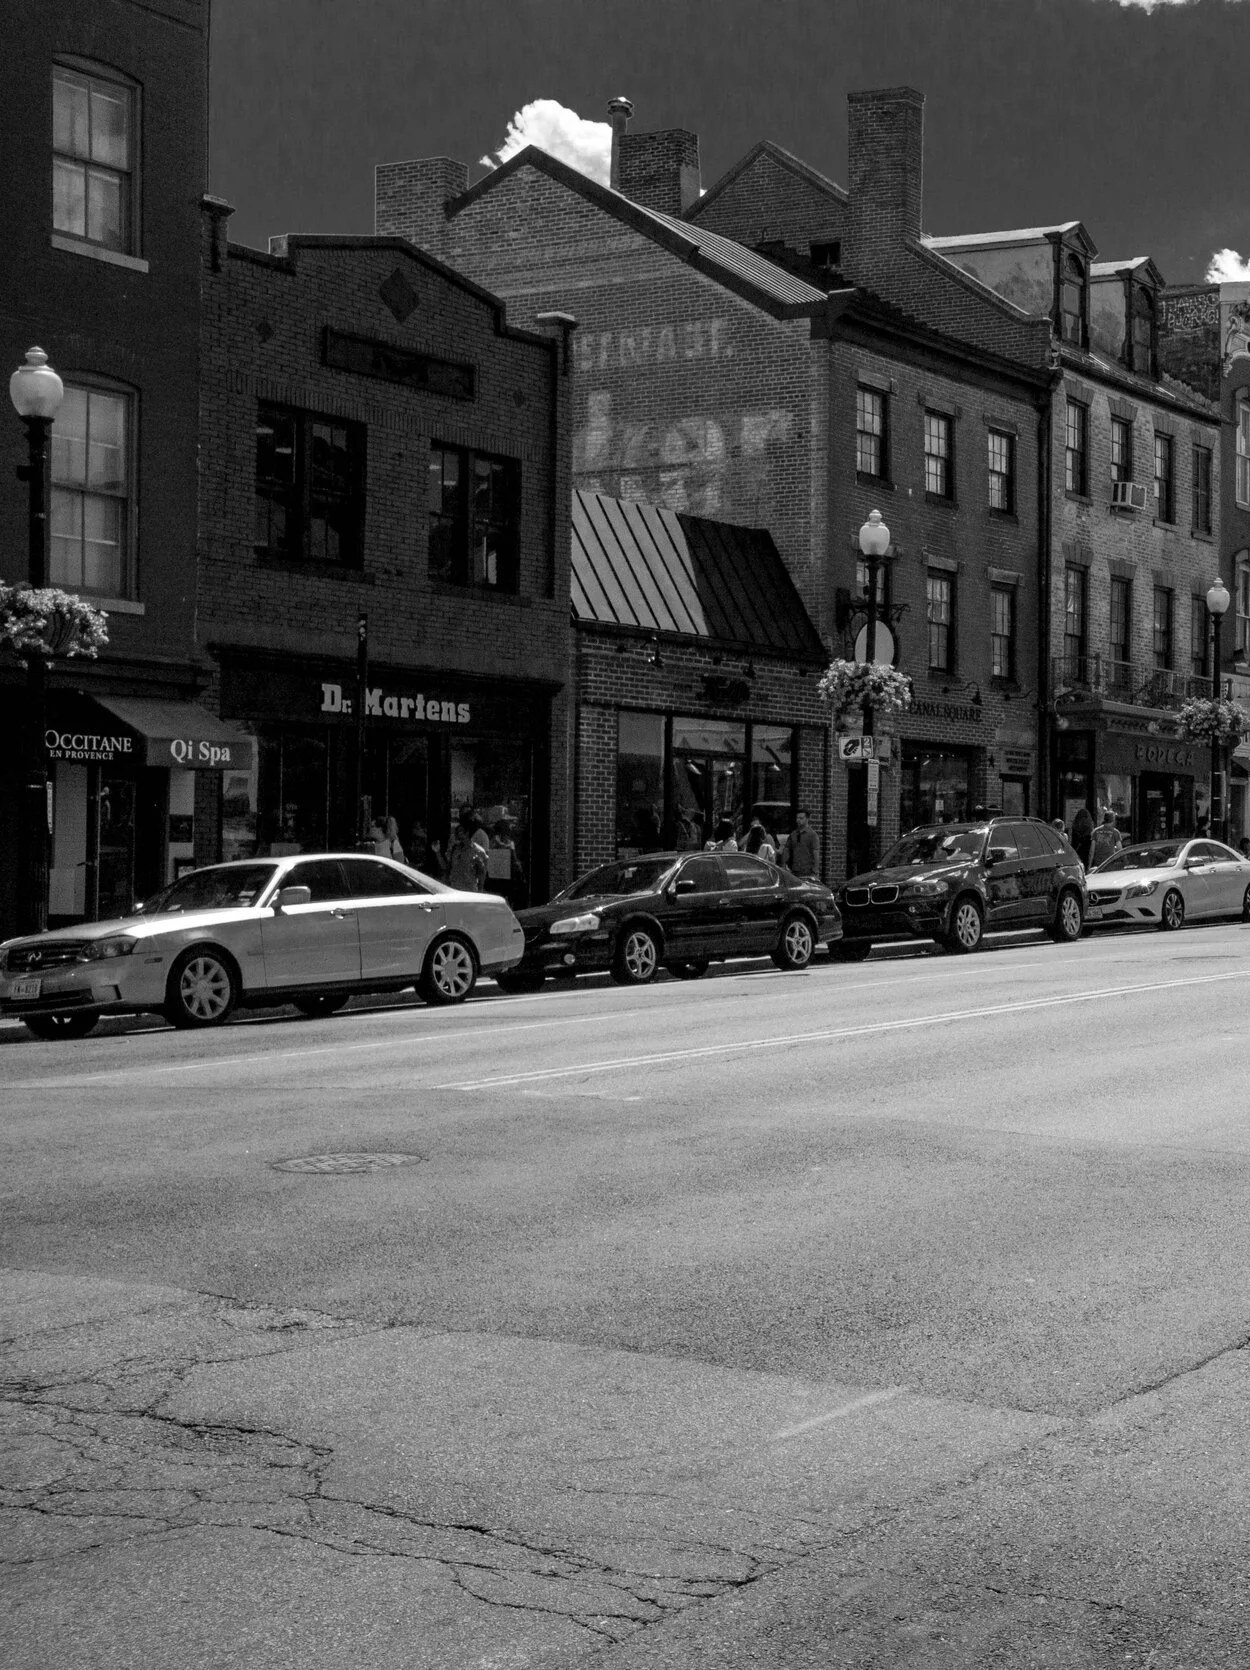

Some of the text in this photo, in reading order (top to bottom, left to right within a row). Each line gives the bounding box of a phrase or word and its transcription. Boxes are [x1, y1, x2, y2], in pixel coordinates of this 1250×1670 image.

[320, 683, 472, 724] Dr. Martens
[944, 704, 983, 722] SQUARE
[49, 749, 114, 761] EN PROVENCE
[170, 739, 231, 766] Qi Spa
[1135, 743, 1194, 767] BODEGA
